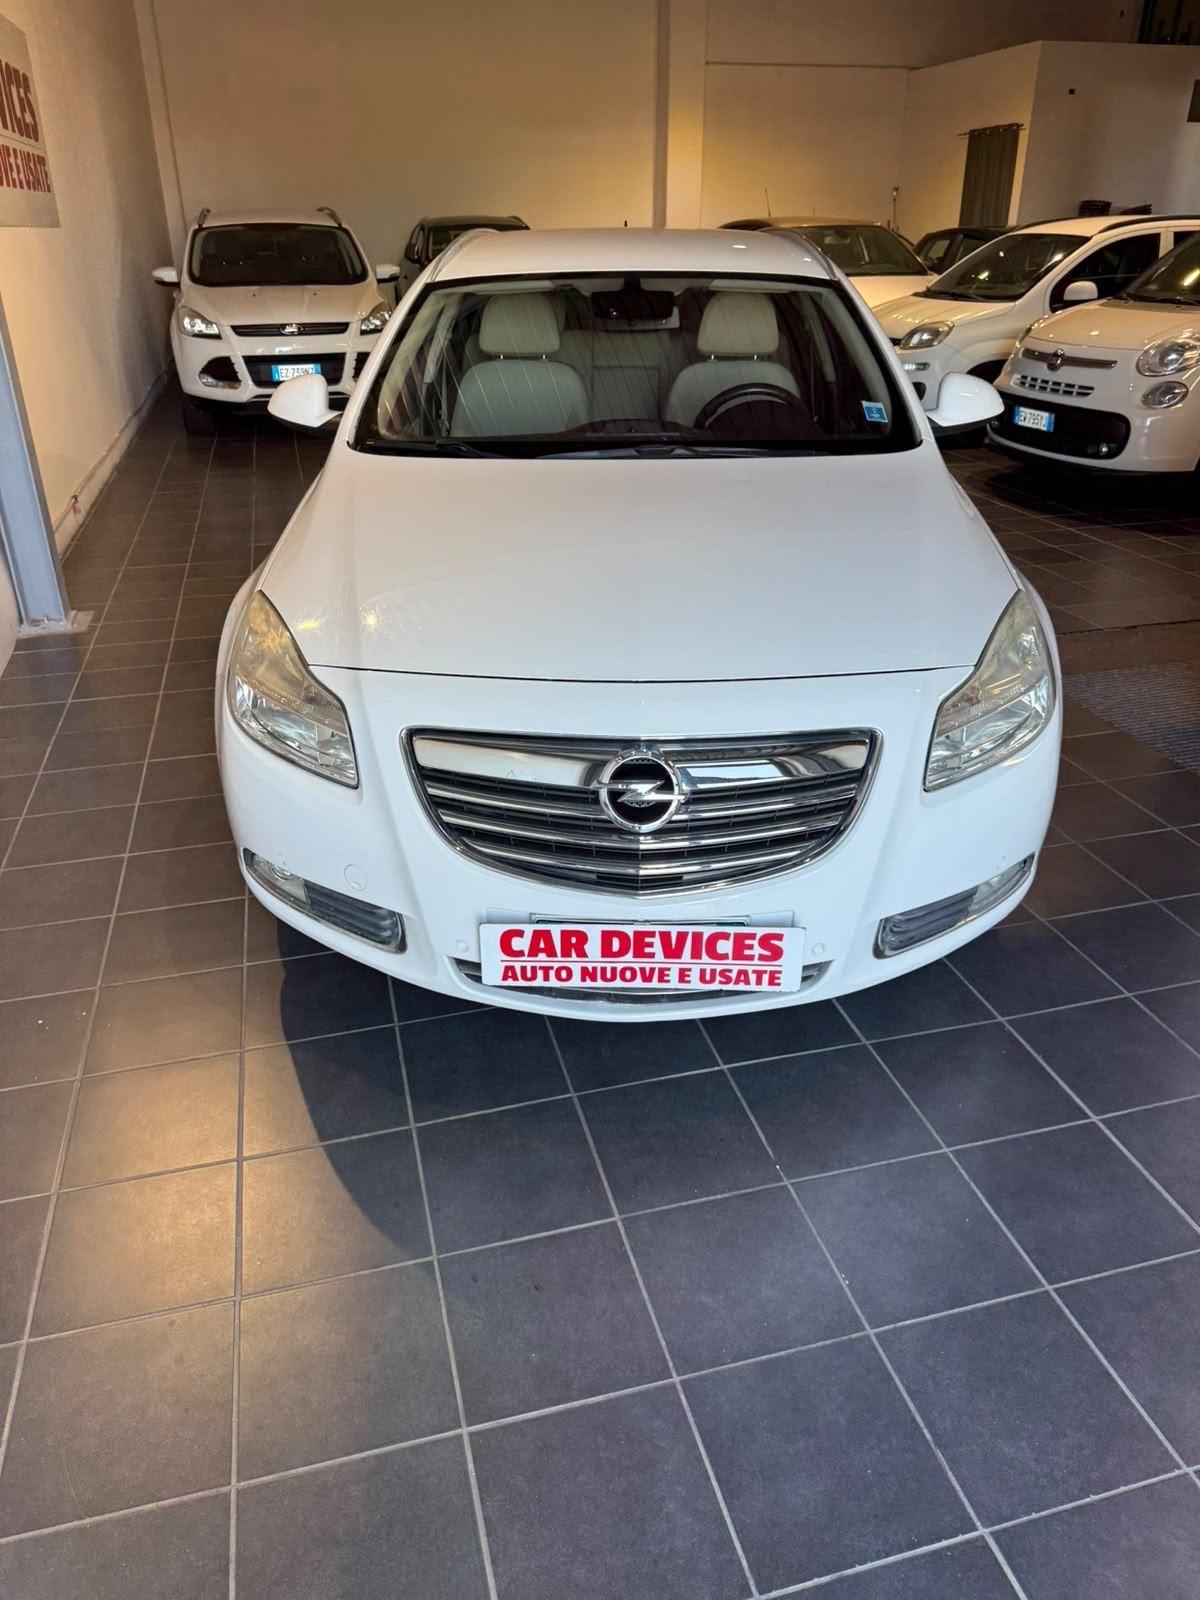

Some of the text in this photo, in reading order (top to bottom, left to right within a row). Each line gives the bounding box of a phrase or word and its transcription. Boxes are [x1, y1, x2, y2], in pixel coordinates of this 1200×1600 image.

[19, 149, 51, 193] USATE
[499, 929, 785, 962] CAR DEVICES
[501, 965, 783, 986] AUTO NUOVE E USATE
